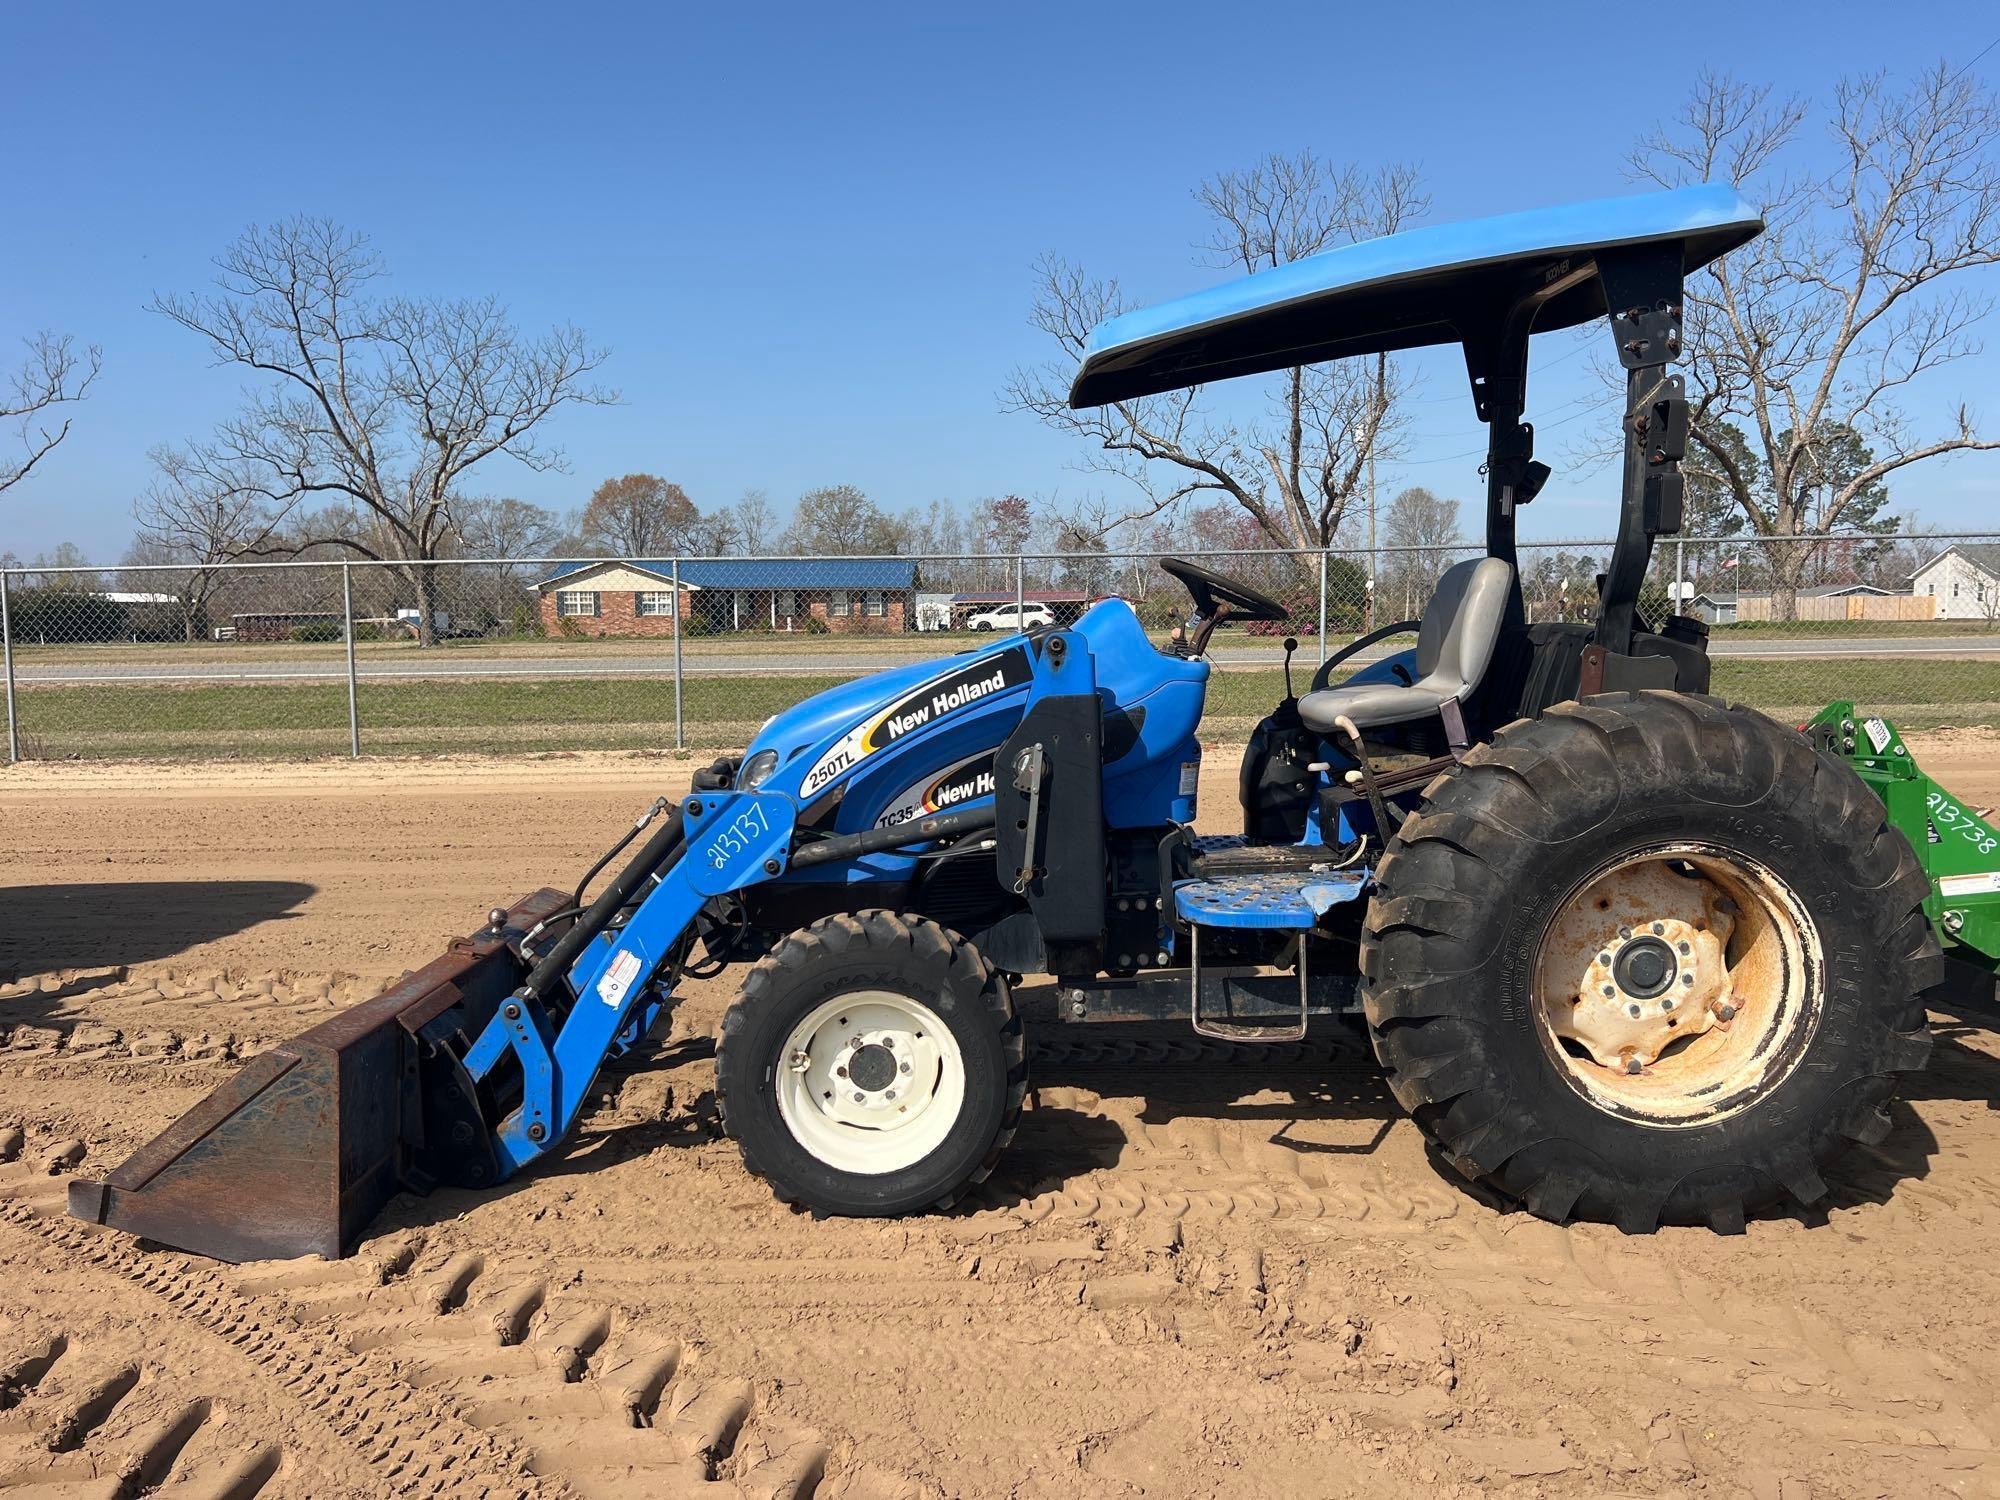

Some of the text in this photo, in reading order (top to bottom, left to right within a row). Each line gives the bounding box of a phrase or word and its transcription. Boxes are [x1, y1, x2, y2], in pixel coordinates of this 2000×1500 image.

[887, 670, 1005, 739] New Holland
[809, 751, 855, 789] 250TL
[937, 782, 974, 806] New
[707, 802, 769, 870] 213737
[1926, 792, 1998, 855] 213738
[1500, 894, 1542, 1022] INDUSTRIAL
[1513, 928, 1537, 1034] TRACTOR
